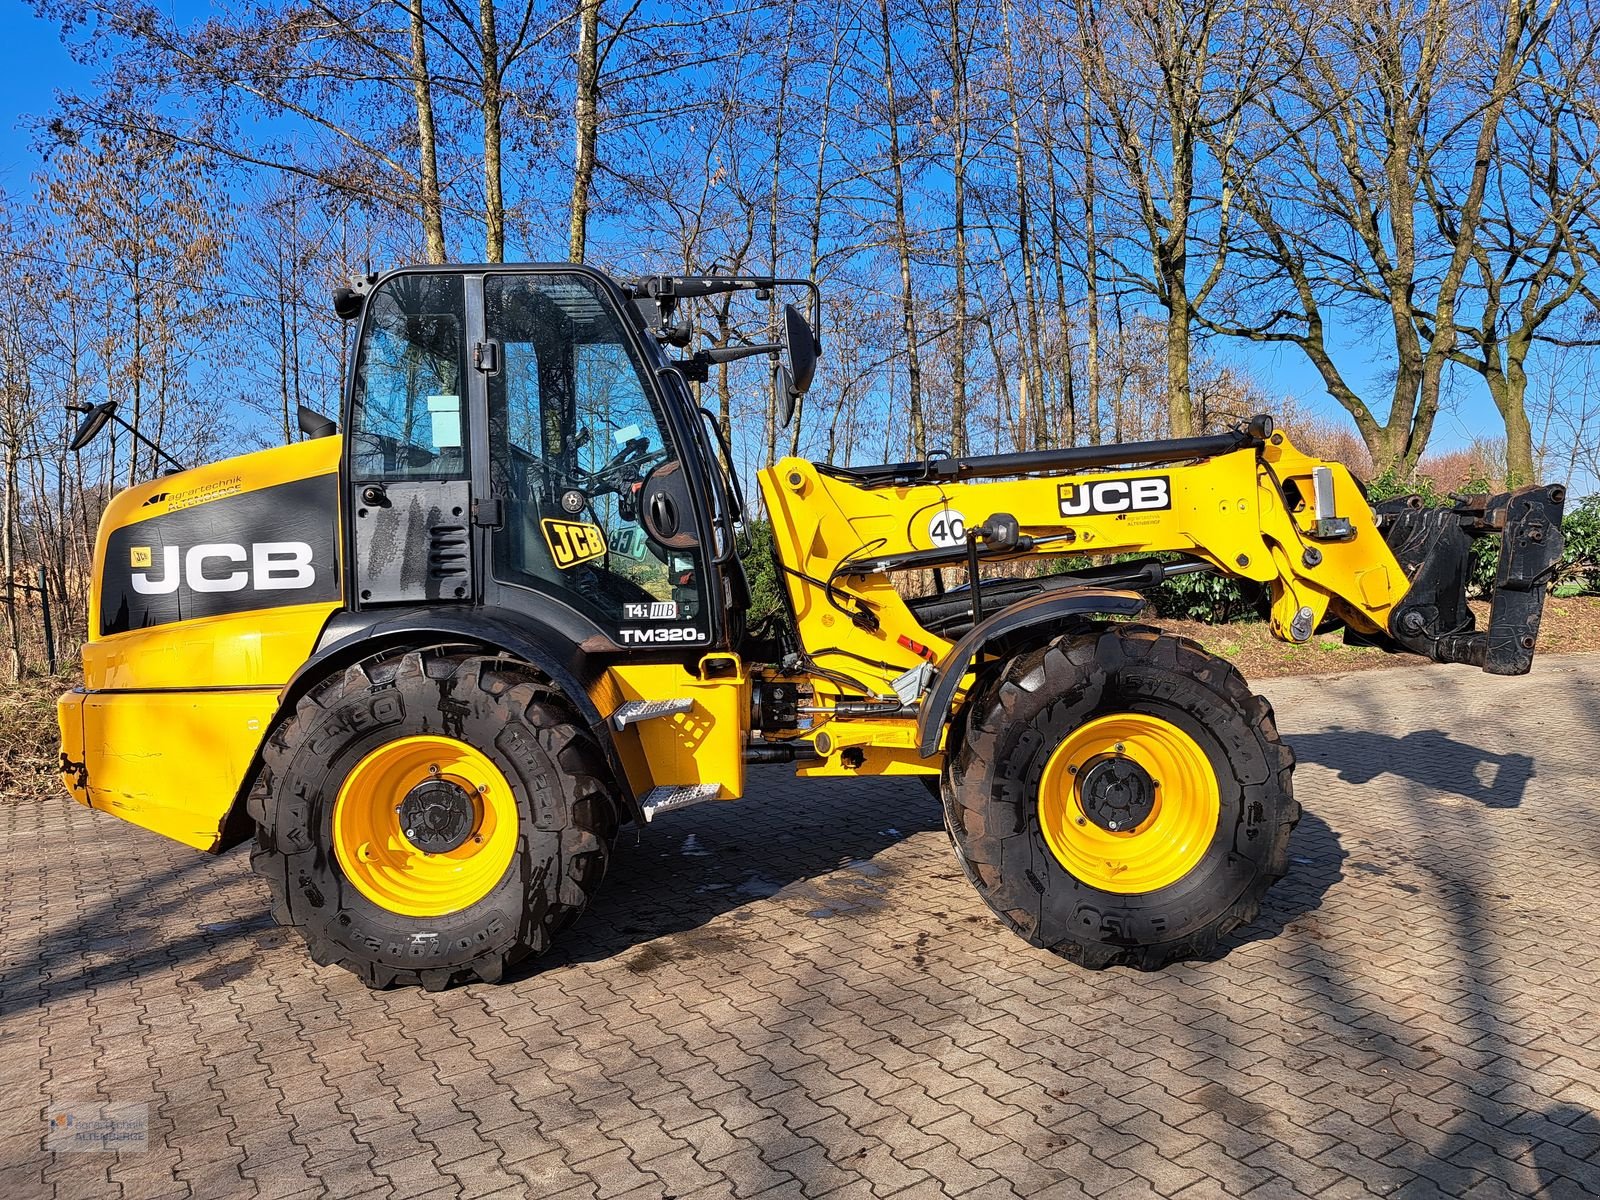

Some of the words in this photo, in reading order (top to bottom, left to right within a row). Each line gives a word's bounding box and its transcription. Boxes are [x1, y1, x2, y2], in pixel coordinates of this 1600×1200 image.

[168, 475, 242, 502] agrartechnik
[168, 484, 242, 511] ALTENBERGE
[1061, 478, 1170, 516] JCB
[931, 518, 967, 541] 40
[553, 523, 602, 564] JCB
[130, 541, 316, 595] JCB
[625, 604, 649, 618] T4i
